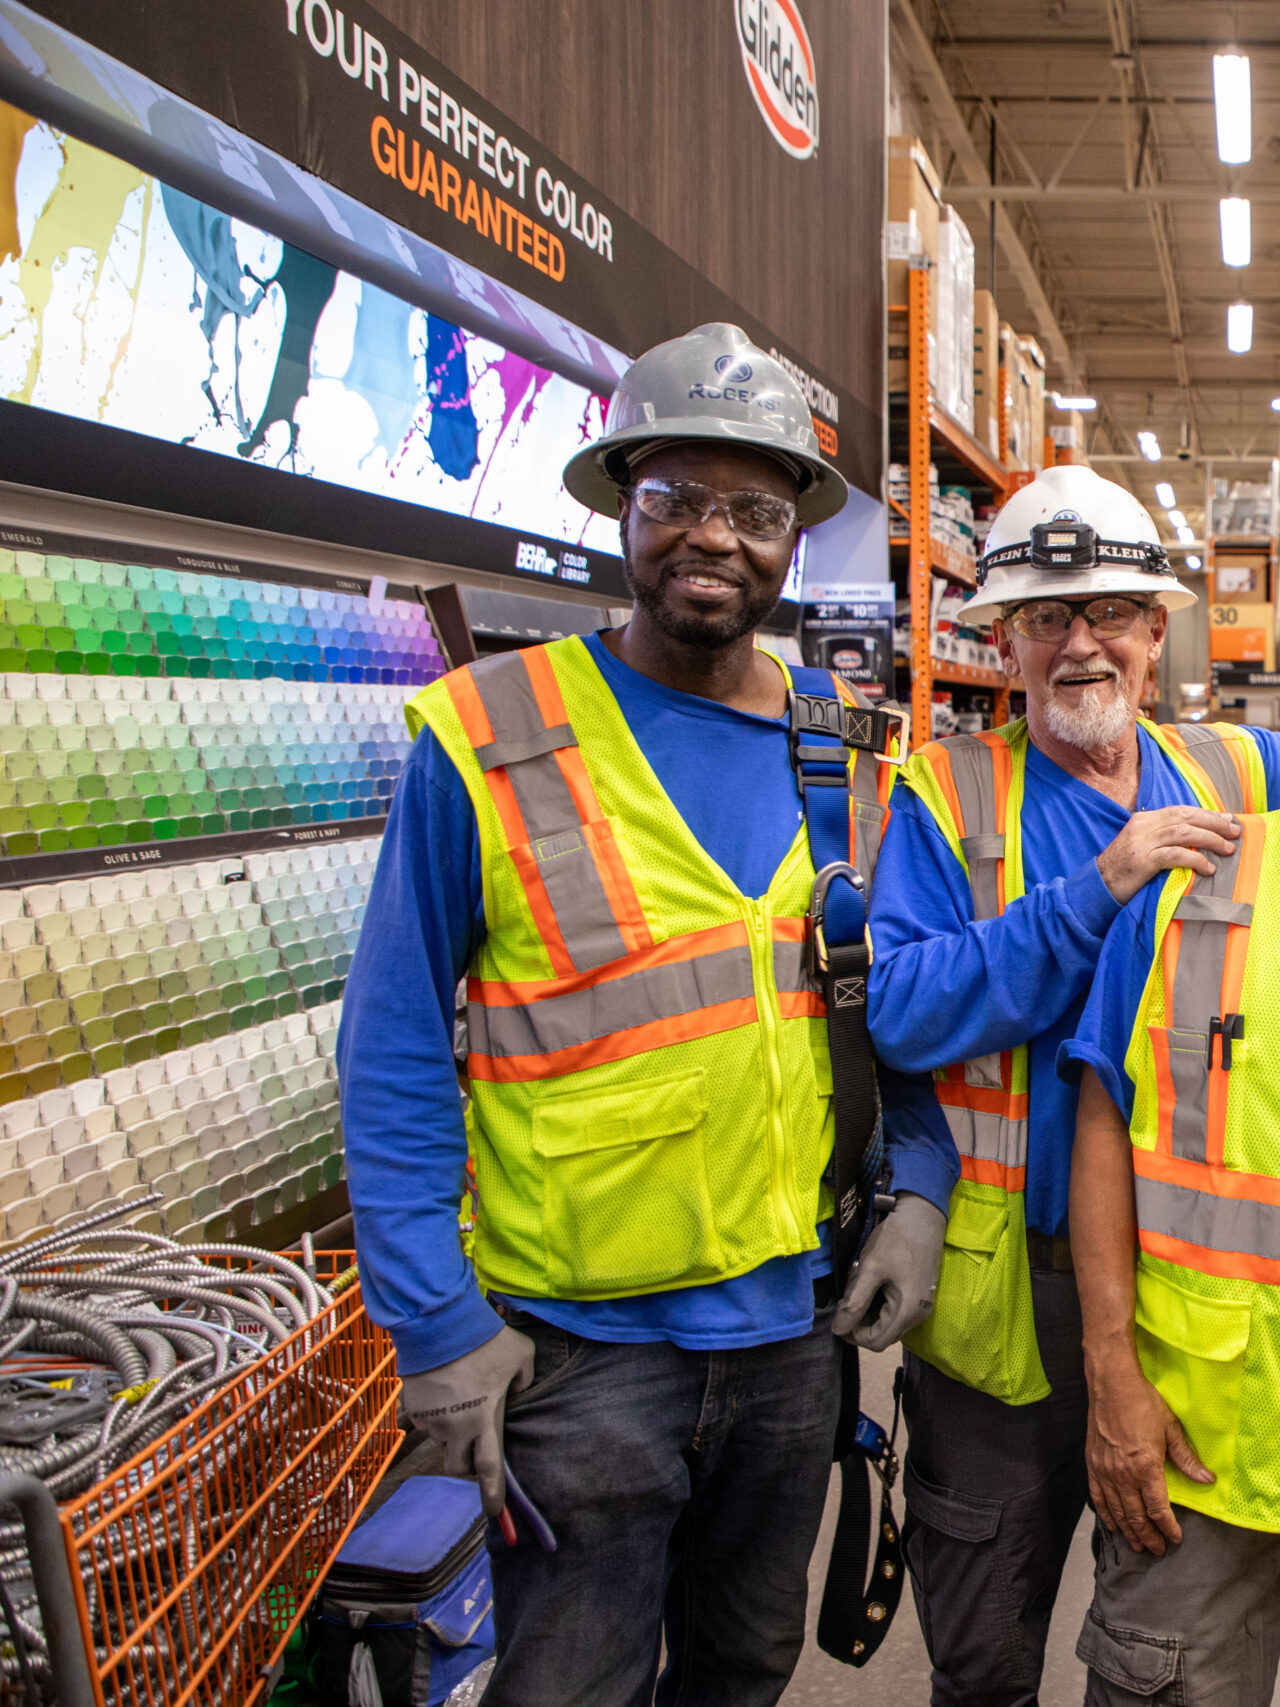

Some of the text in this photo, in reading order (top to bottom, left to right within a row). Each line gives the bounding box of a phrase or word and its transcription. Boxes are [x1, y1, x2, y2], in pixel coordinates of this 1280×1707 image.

[737, 0, 817, 138] Glidden
[285, 0, 613, 262] YOUR PERFECT COLOR
[370, 114, 566, 283] GUARANTEED
[689, 383, 776, 411] ROGERS
[1, 531, 44, 546] EMERALD
[515, 541, 549, 574] BEHR
[562, 552, 588, 570] COLOR
[987, 546, 1023, 567] KLEIN
[1097, 545, 1151, 560] KLEIN
[177, 556, 217, 570] TURQUOISE
[224, 562, 241, 573] BLUE
[561, 566, 591, 584] LIBRARY
[1213, 607, 1239, 625] 30
[294, 830, 317, 841] FOREST
[323, 828, 341, 839] NAVY
[104, 849, 162, 865] OLIVE & SAGE
[449, 1395, 489, 1413] GRIP
